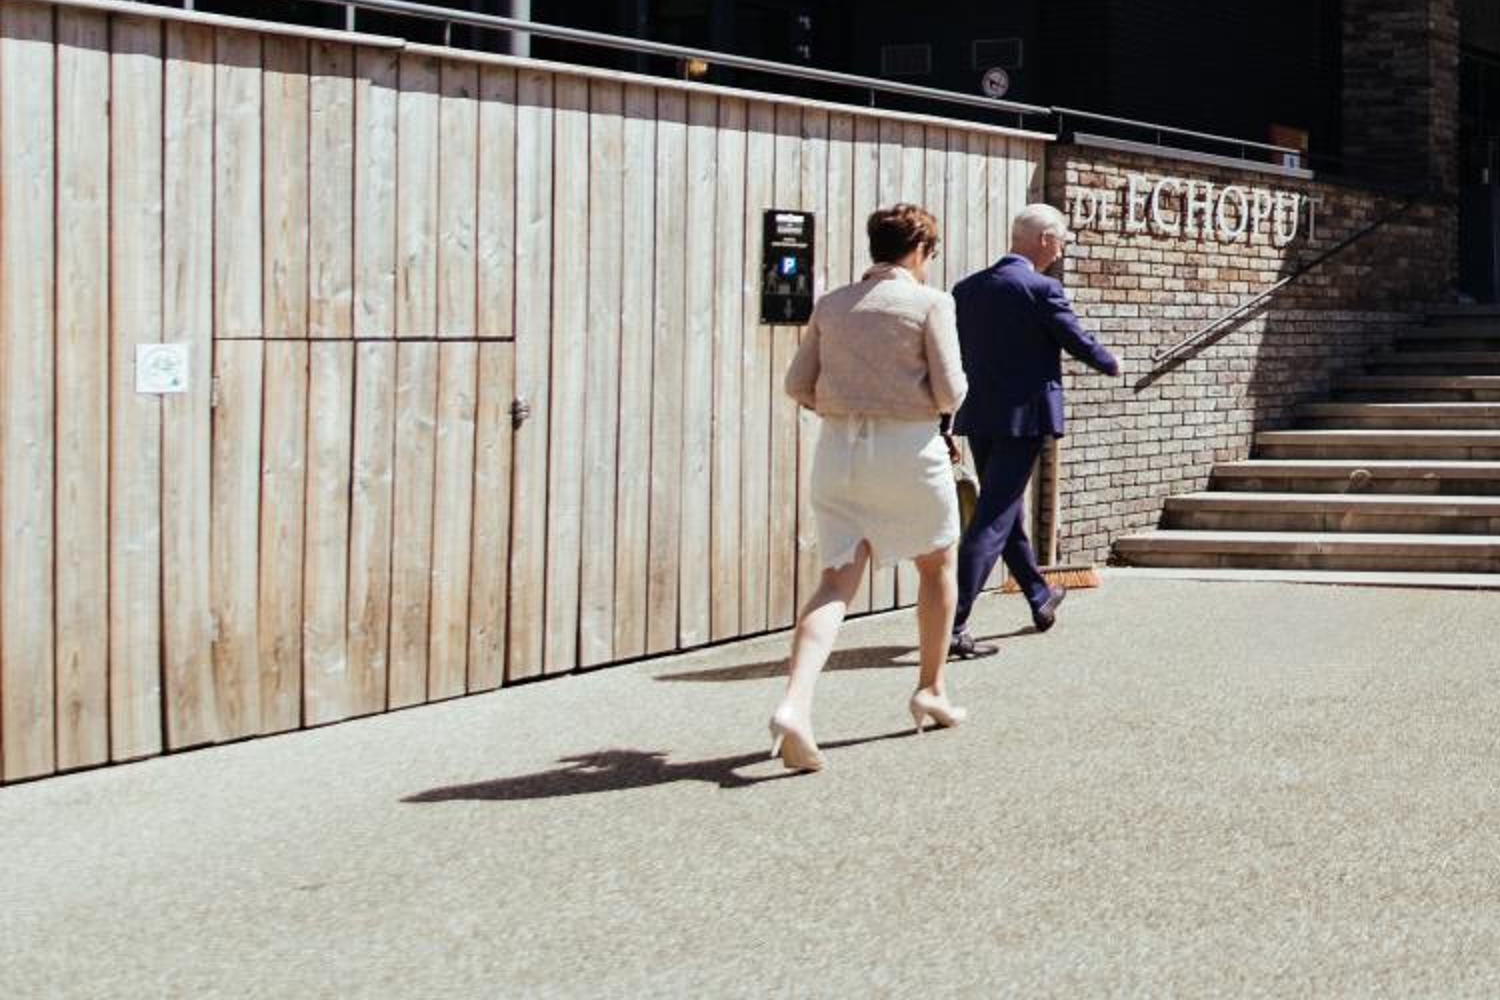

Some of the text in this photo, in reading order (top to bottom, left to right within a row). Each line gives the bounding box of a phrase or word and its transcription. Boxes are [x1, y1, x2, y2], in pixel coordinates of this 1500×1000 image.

[1073, 172, 1324, 244] DE ECHOPUT
[783, 257, 797, 274] P
